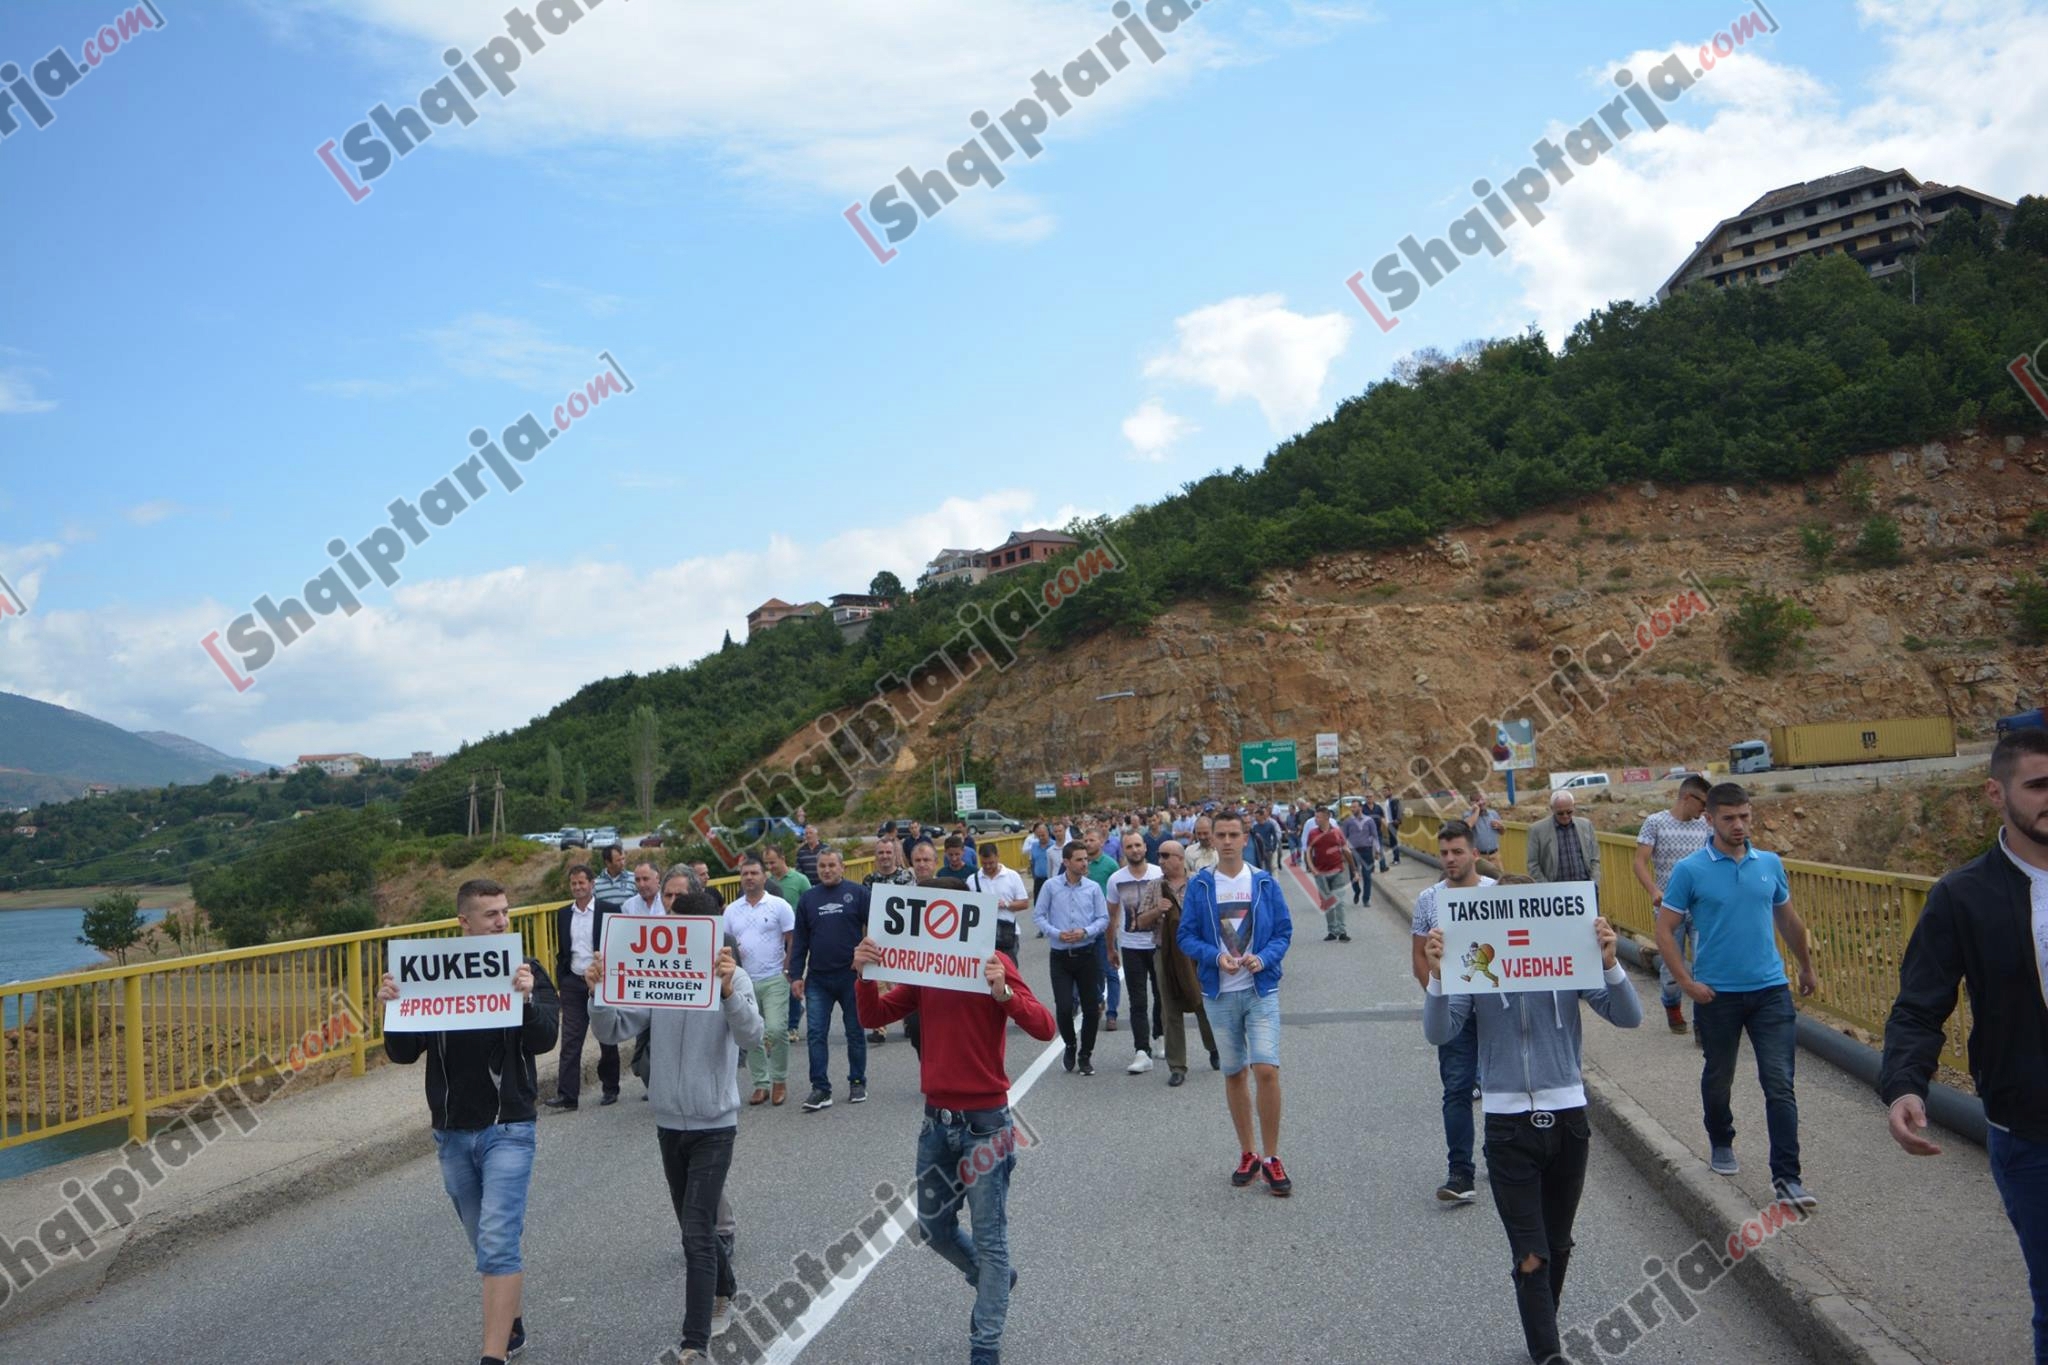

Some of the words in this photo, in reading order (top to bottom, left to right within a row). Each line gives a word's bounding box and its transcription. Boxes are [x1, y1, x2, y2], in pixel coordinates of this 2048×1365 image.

[1448, 899, 1514, 922] TAKSIMI
[1519, 895, 1585, 919] RRUGES
[630, 925, 688, 955] JO!
[400, 949, 511, 983] KUKESI
[877, 946, 981, 979] KORRUPSIONIT
[1501, 955, 1574, 978] VJEDHJE
[627, 979, 645, 988] NË
[648, 980, 703, 991] RRUGËN
[633, 991, 641, 999] E
[645, 991, 696, 1001] KOMBIT
[400, 993, 512, 1017] #PROTESTON
